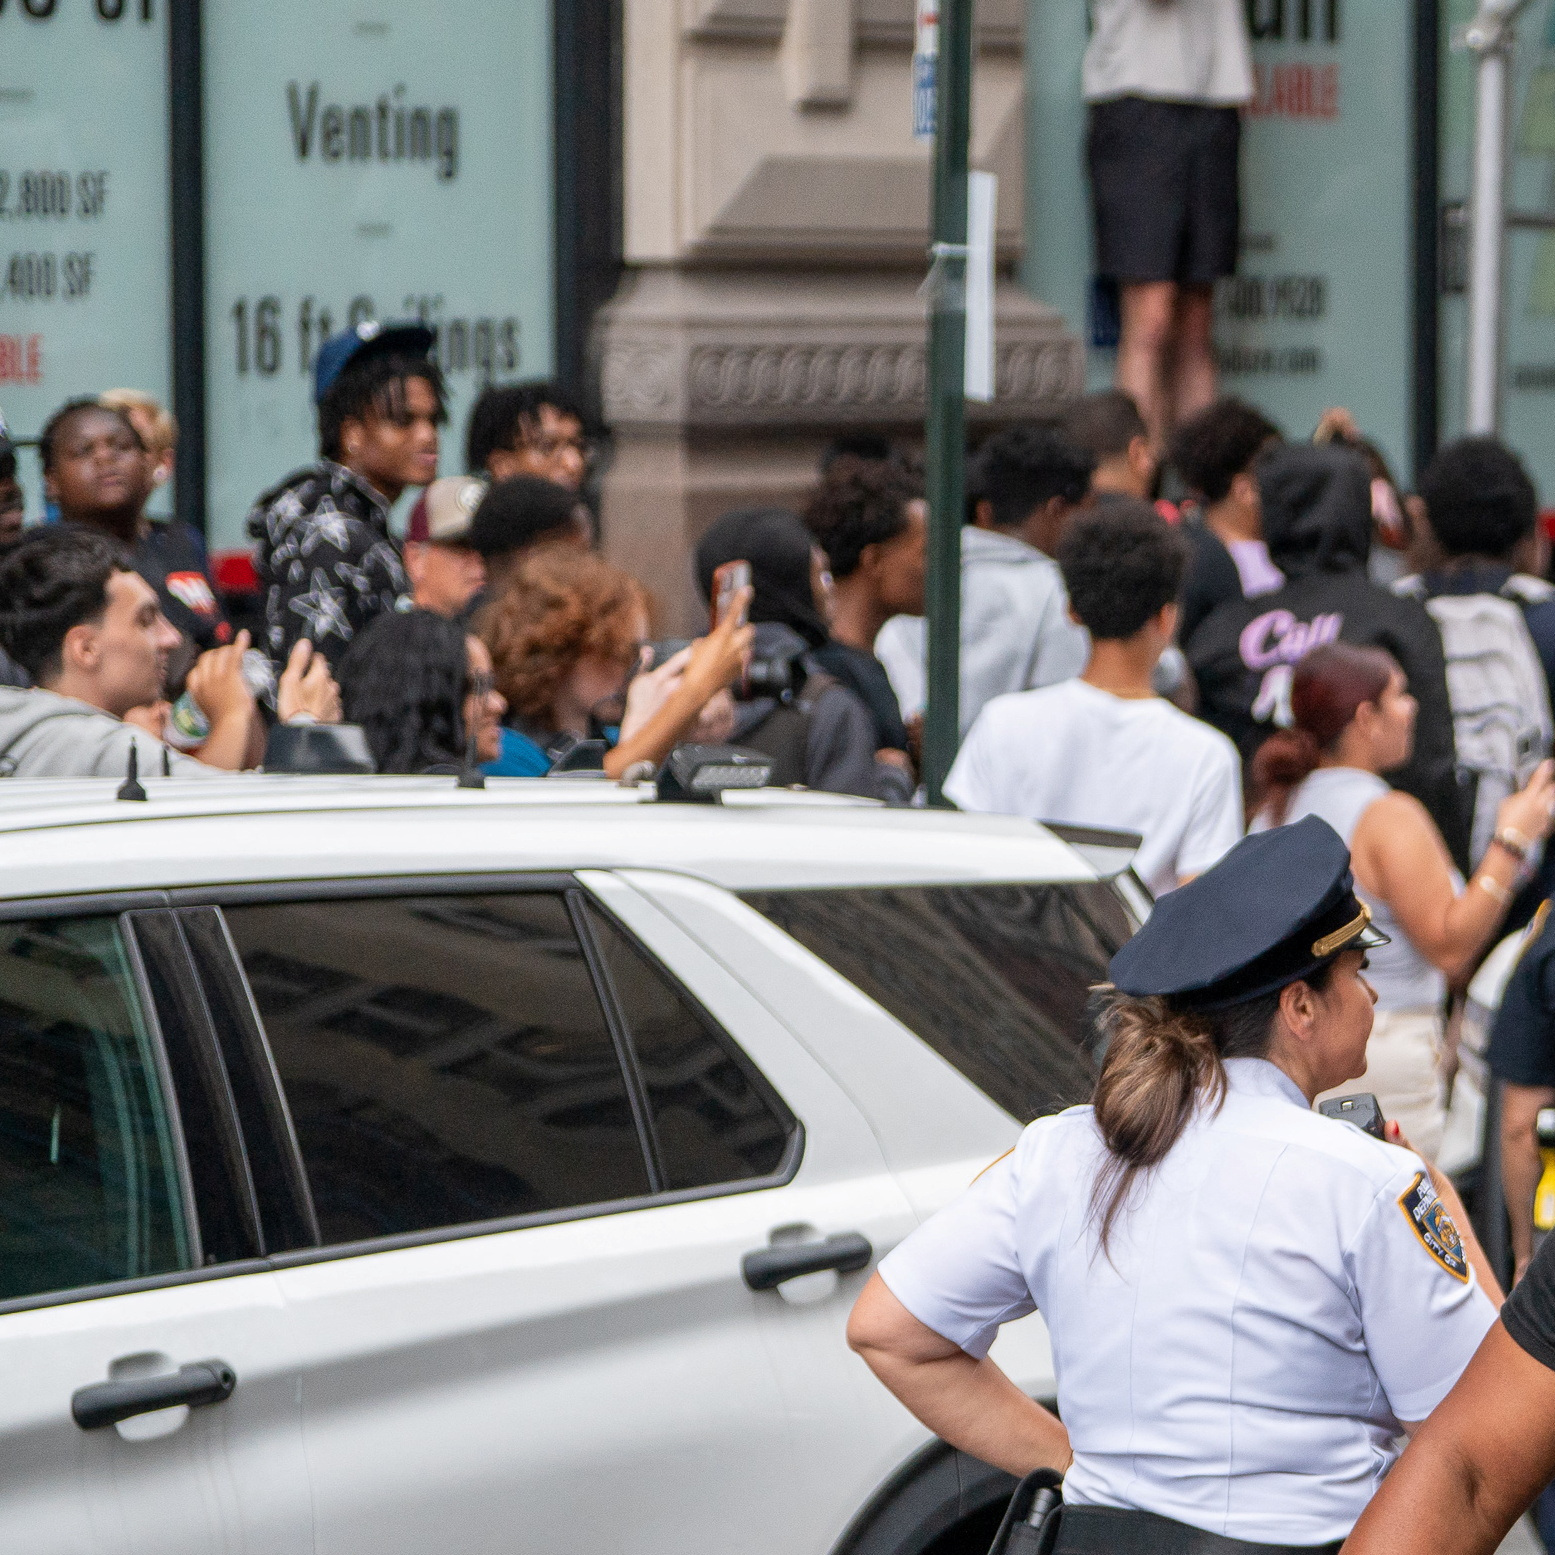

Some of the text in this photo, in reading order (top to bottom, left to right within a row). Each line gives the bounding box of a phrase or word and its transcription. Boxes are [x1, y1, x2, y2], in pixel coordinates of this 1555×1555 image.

[286, 80, 459, 184] Venting
[76, 170, 110, 220] SF
[62, 253, 95, 300] SF
[231, 295, 283, 378] 16
